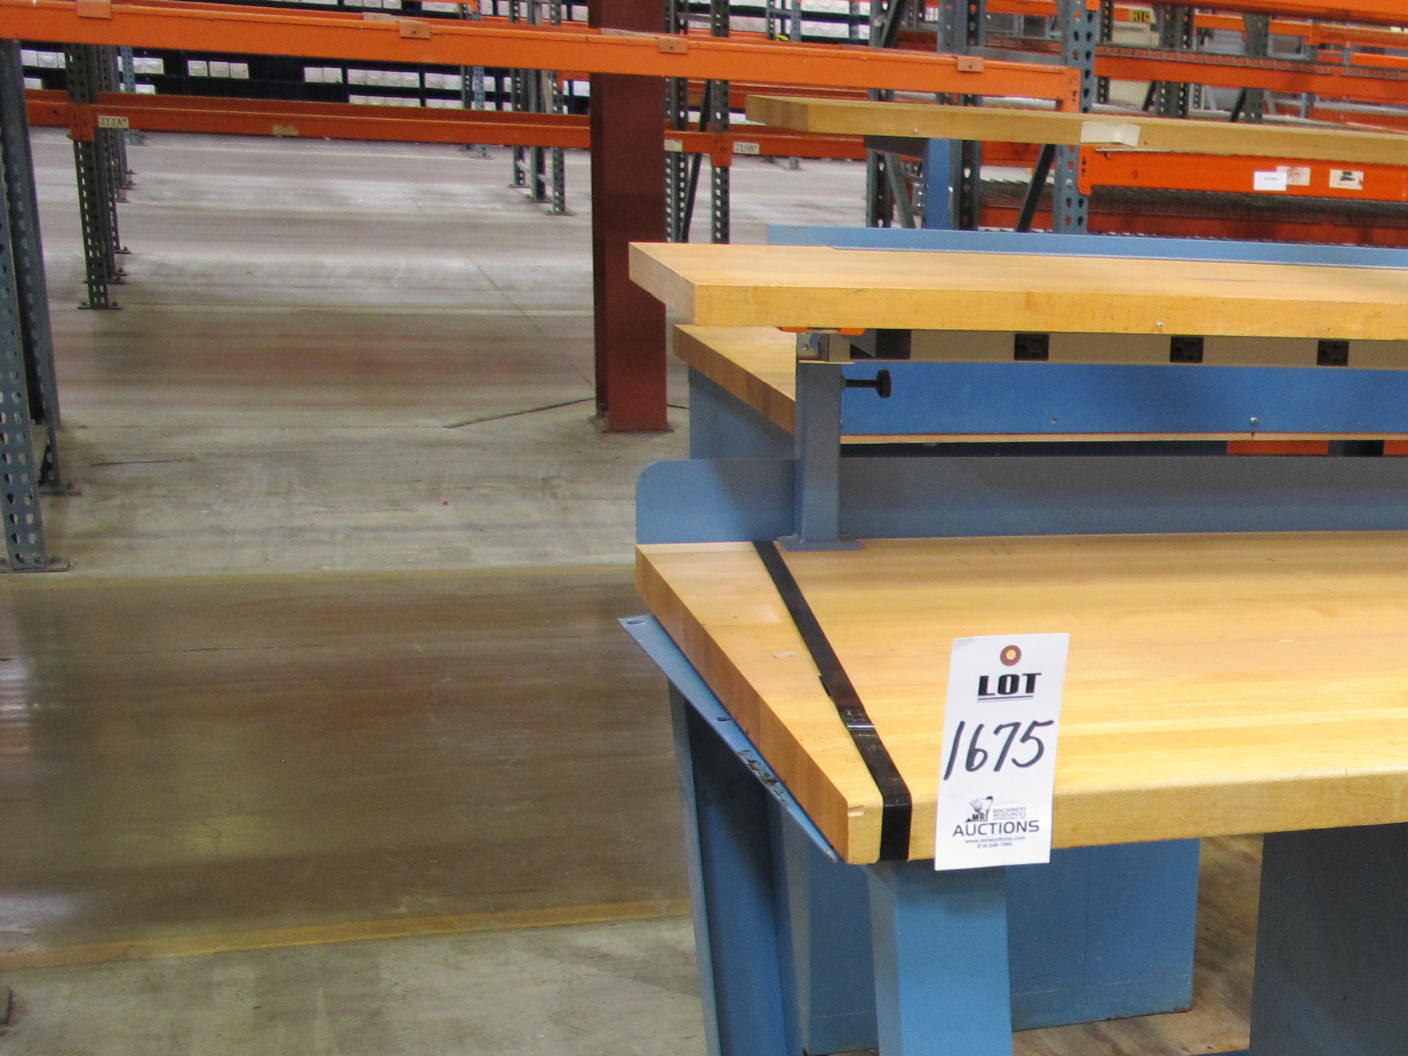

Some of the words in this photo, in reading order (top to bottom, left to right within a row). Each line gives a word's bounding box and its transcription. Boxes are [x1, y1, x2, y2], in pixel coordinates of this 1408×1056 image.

[978, 672, 1042, 697] LOT
[943, 719, 1054, 781] 1675
[952, 820, 1040, 837] AUCTIONS
